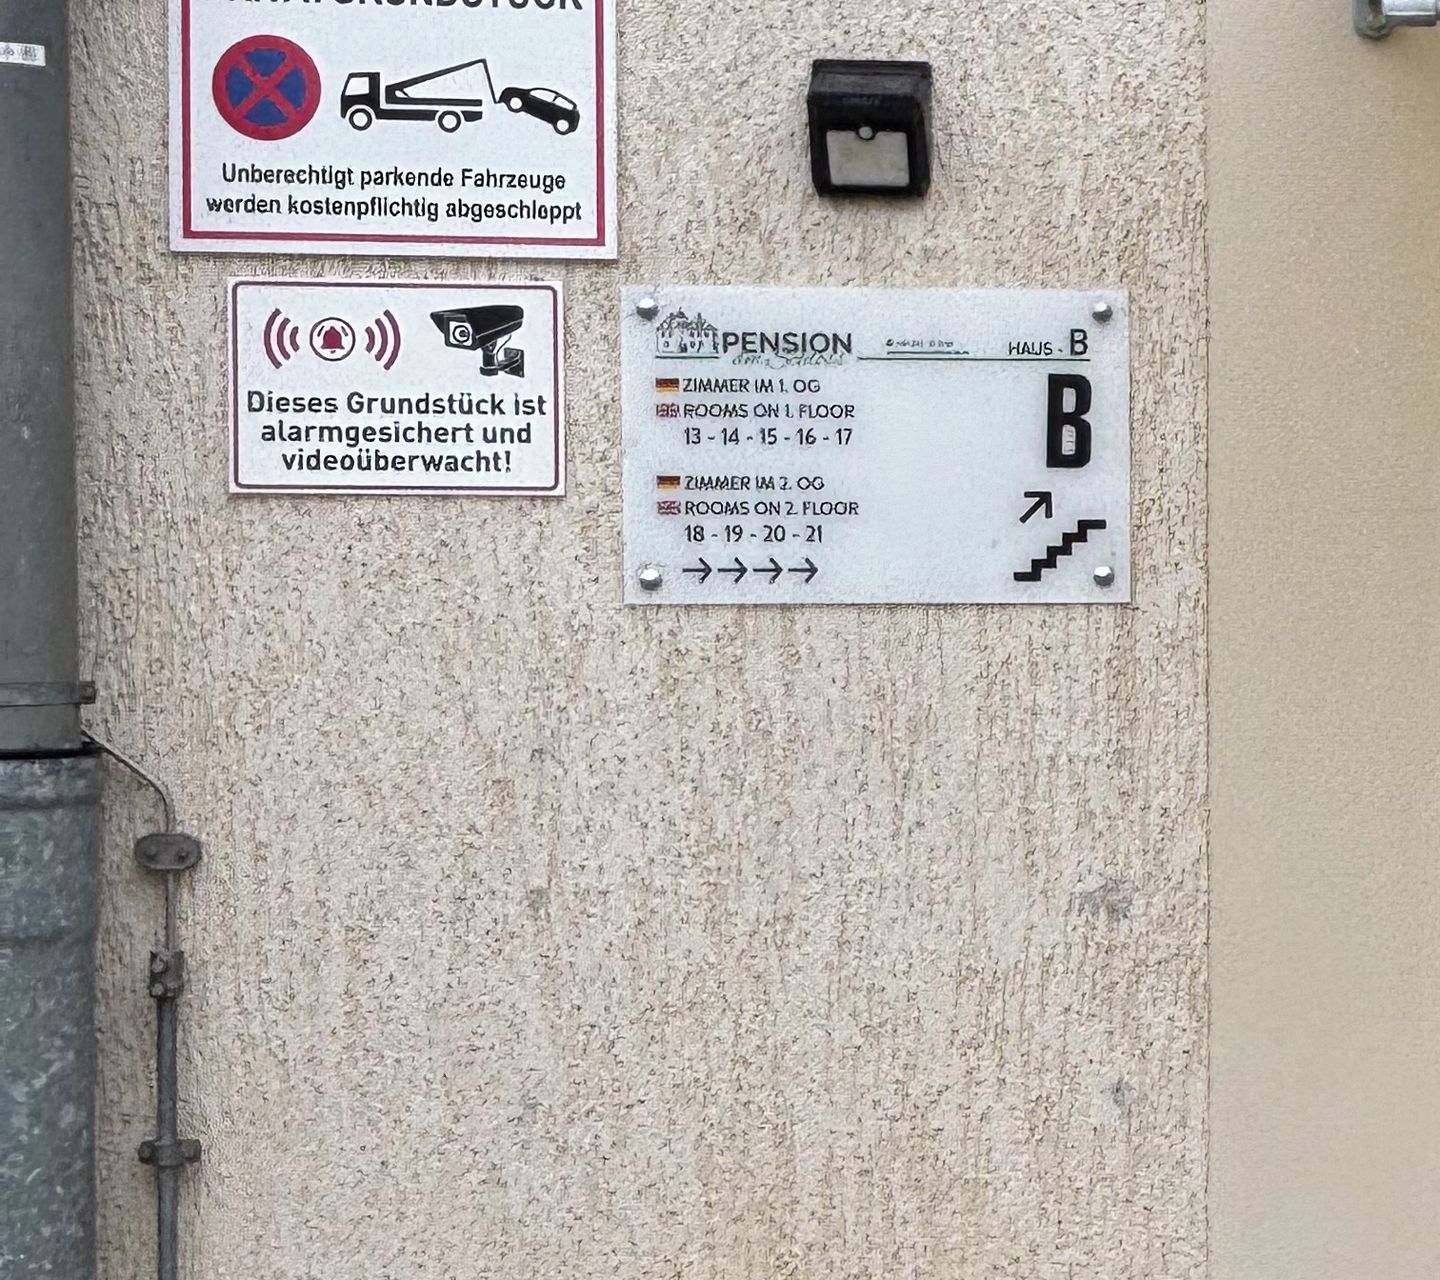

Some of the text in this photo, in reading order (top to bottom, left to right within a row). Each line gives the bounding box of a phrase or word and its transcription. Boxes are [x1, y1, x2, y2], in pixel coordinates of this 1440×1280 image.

[221, 162, 566, 191] Unberechtigt parkende Fahrzeuge
[206, 195, 582, 223] werden kostenpflichtig abgeschleppt
[722, 332, 852, 354] PENSION
[1008, 341, 1053, 356] HAUS
[1070, 329, 1088, 356] B
[683, 378, 821, 393] ZIMMER IM 1. OG
[247, 390, 547, 416] Dieses Grundstück ist
[684, 404, 748, 418] ROOMS
[754, 404, 779, 418] ON
[799, 404, 855, 418] FLOOR
[1046, 373, 1091, 468] B
[261, 420, 531, 447] alarmgesichert und
[684, 427, 701, 445] 13
[721, 428, 739, 445] 14
[760, 428, 777, 445] 15
[797, 428, 816, 445] 16
[836, 428, 853, 445] 17
[281, 448, 511, 473] videoüberwacht!
[684, 476, 750, 490] ZIMMER
[756, 476, 775, 490] IM
[797, 476, 825, 490] OG
[685, 501, 750, 516] ROOMS
[754, 502, 781, 516] ON
[802, 502, 859, 516] FLOOR
[684, 525, 705, 542] 18
[724, 525, 743, 543] 19
[763, 525, 786, 543] 20
[806, 525, 823, 543] 21
